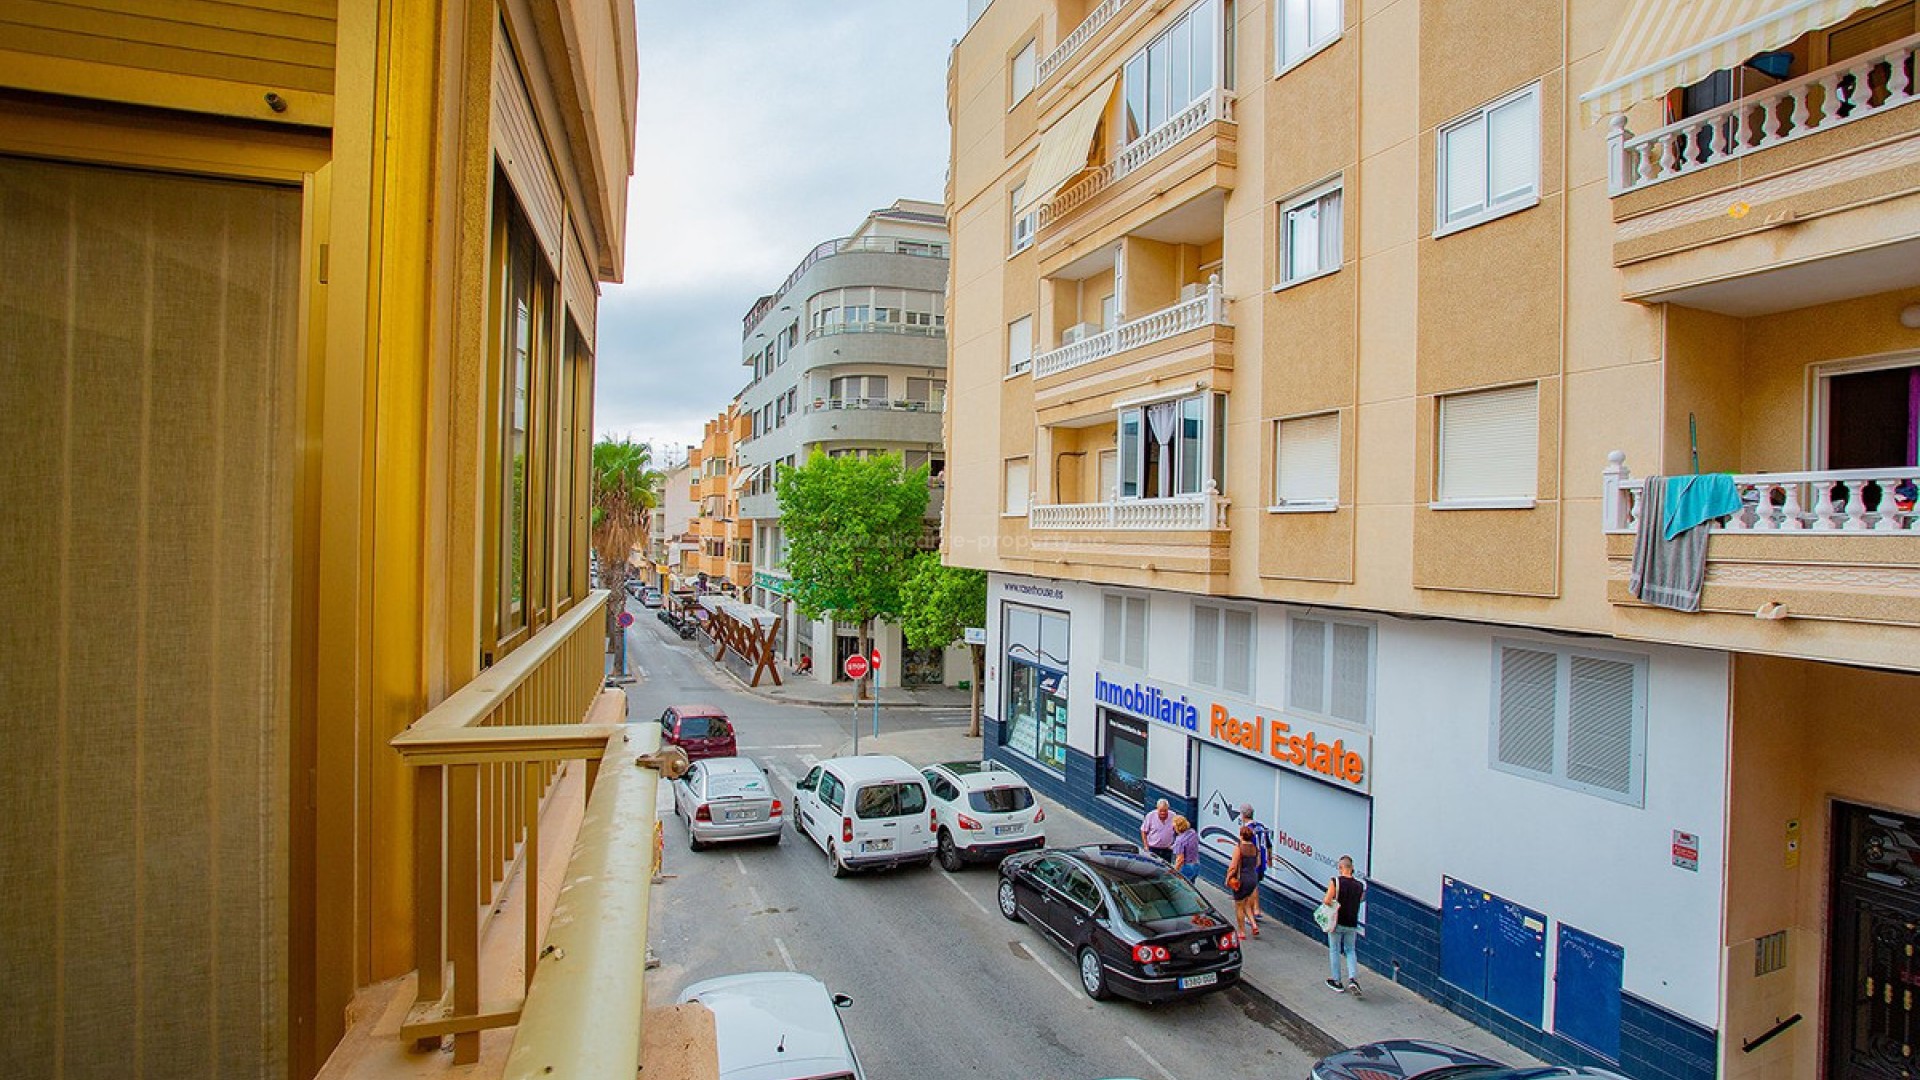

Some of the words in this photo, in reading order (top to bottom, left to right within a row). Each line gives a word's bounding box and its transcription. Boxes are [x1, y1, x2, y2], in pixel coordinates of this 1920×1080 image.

[847, 662, 867, 671] STOP
[1095, 672, 1199, 732] Inmobiliaria
[1210, 703, 1263, 753] Real
[1270, 720, 1364, 784] Estate
[1279, 830, 1313, 857] House
